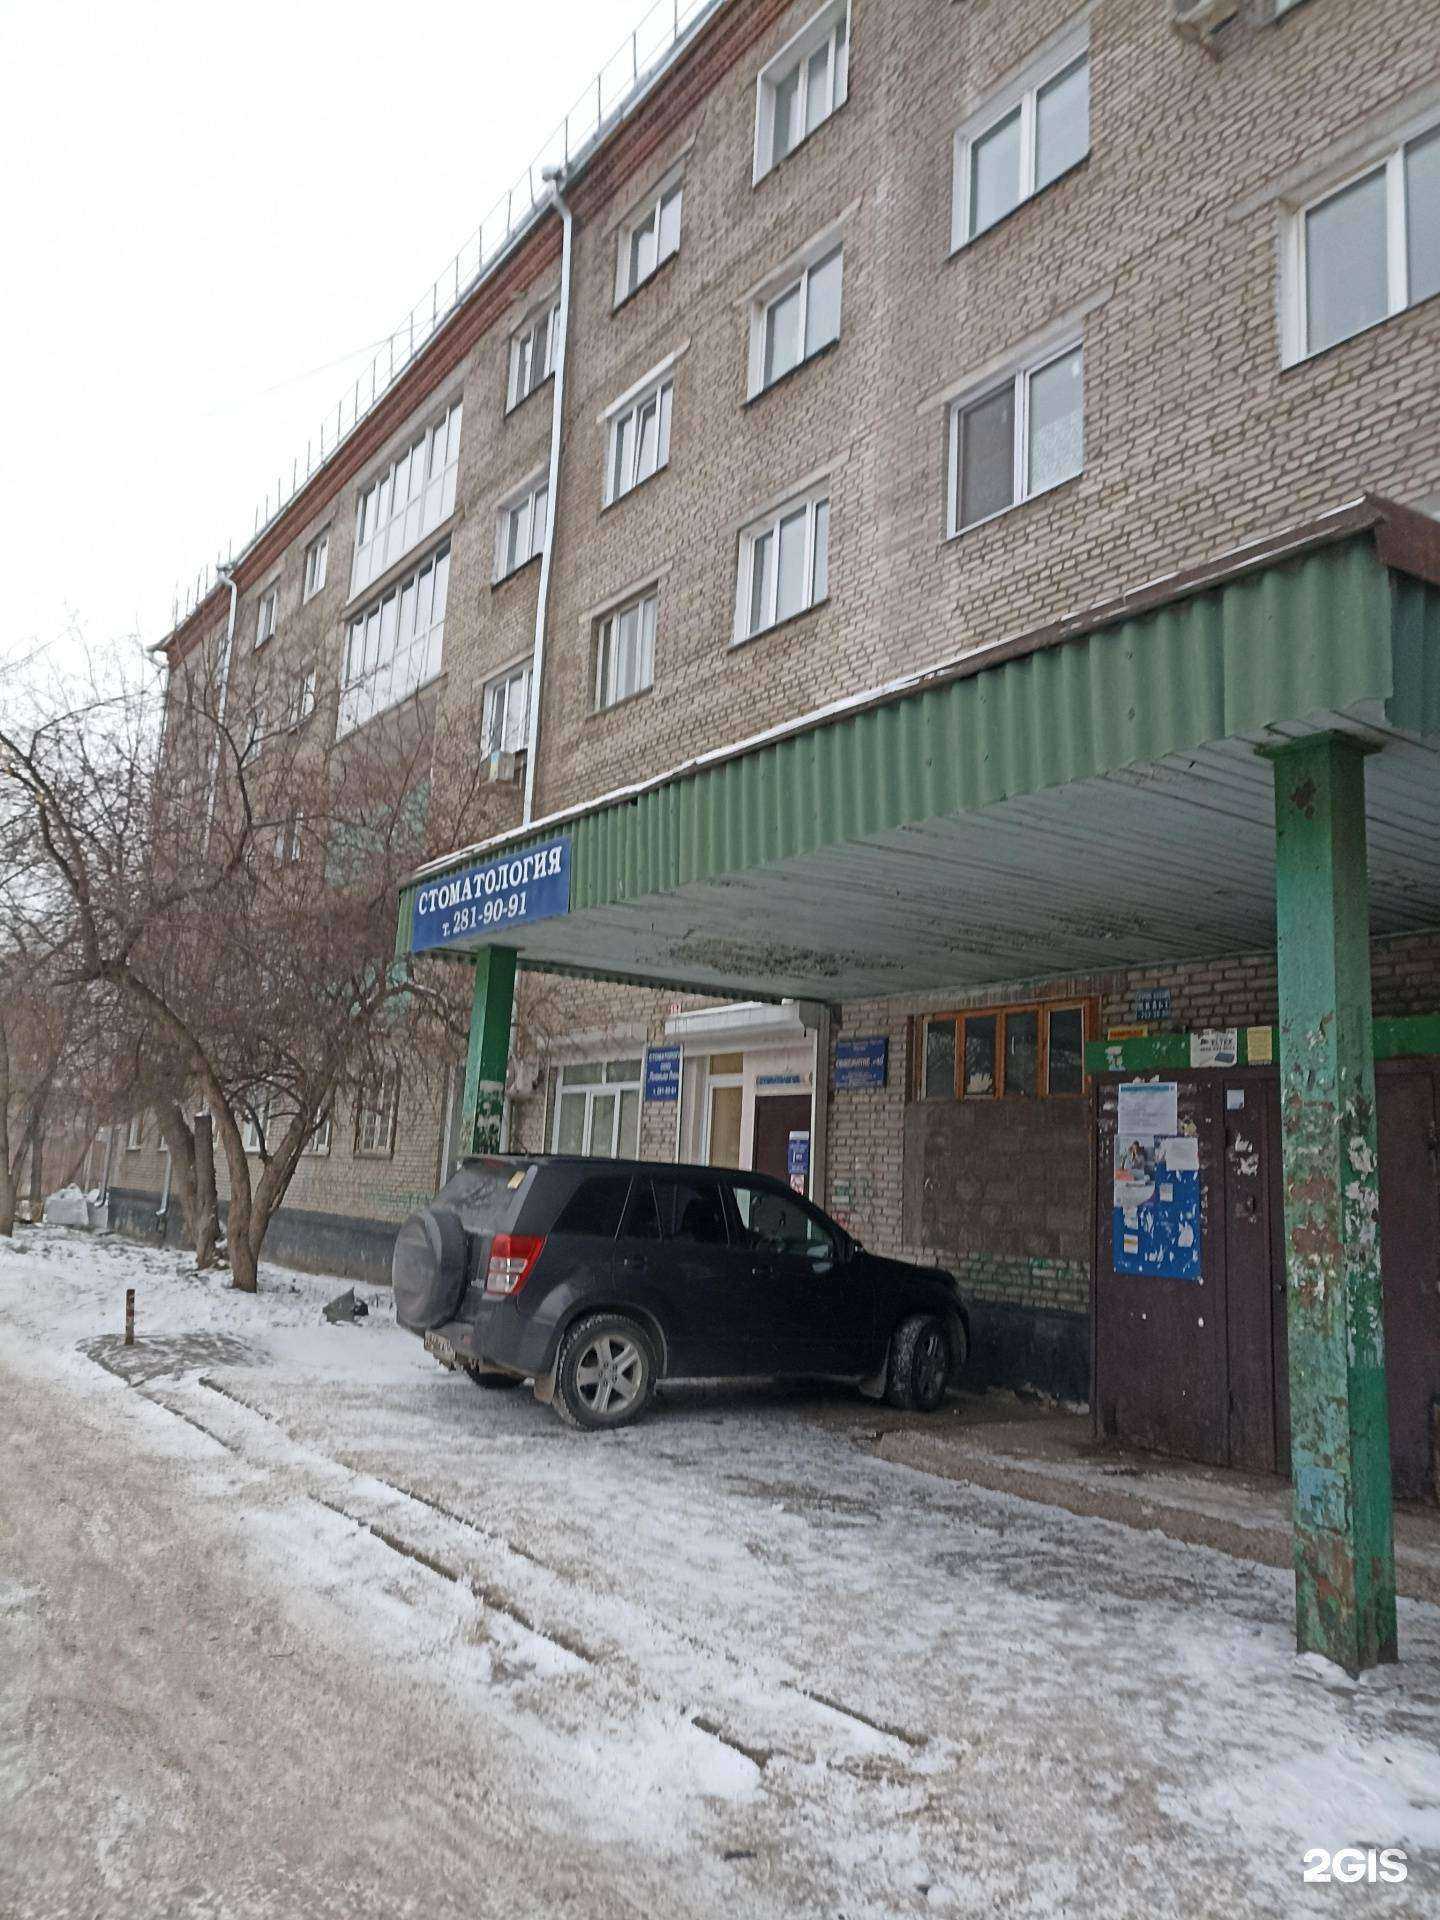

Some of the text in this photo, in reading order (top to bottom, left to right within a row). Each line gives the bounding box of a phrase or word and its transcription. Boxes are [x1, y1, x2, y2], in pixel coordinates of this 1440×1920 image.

[418, 846, 563, 915] СТОМАТОЛОГИЯ
[441, 891, 527, 937] т. 281-90-91
